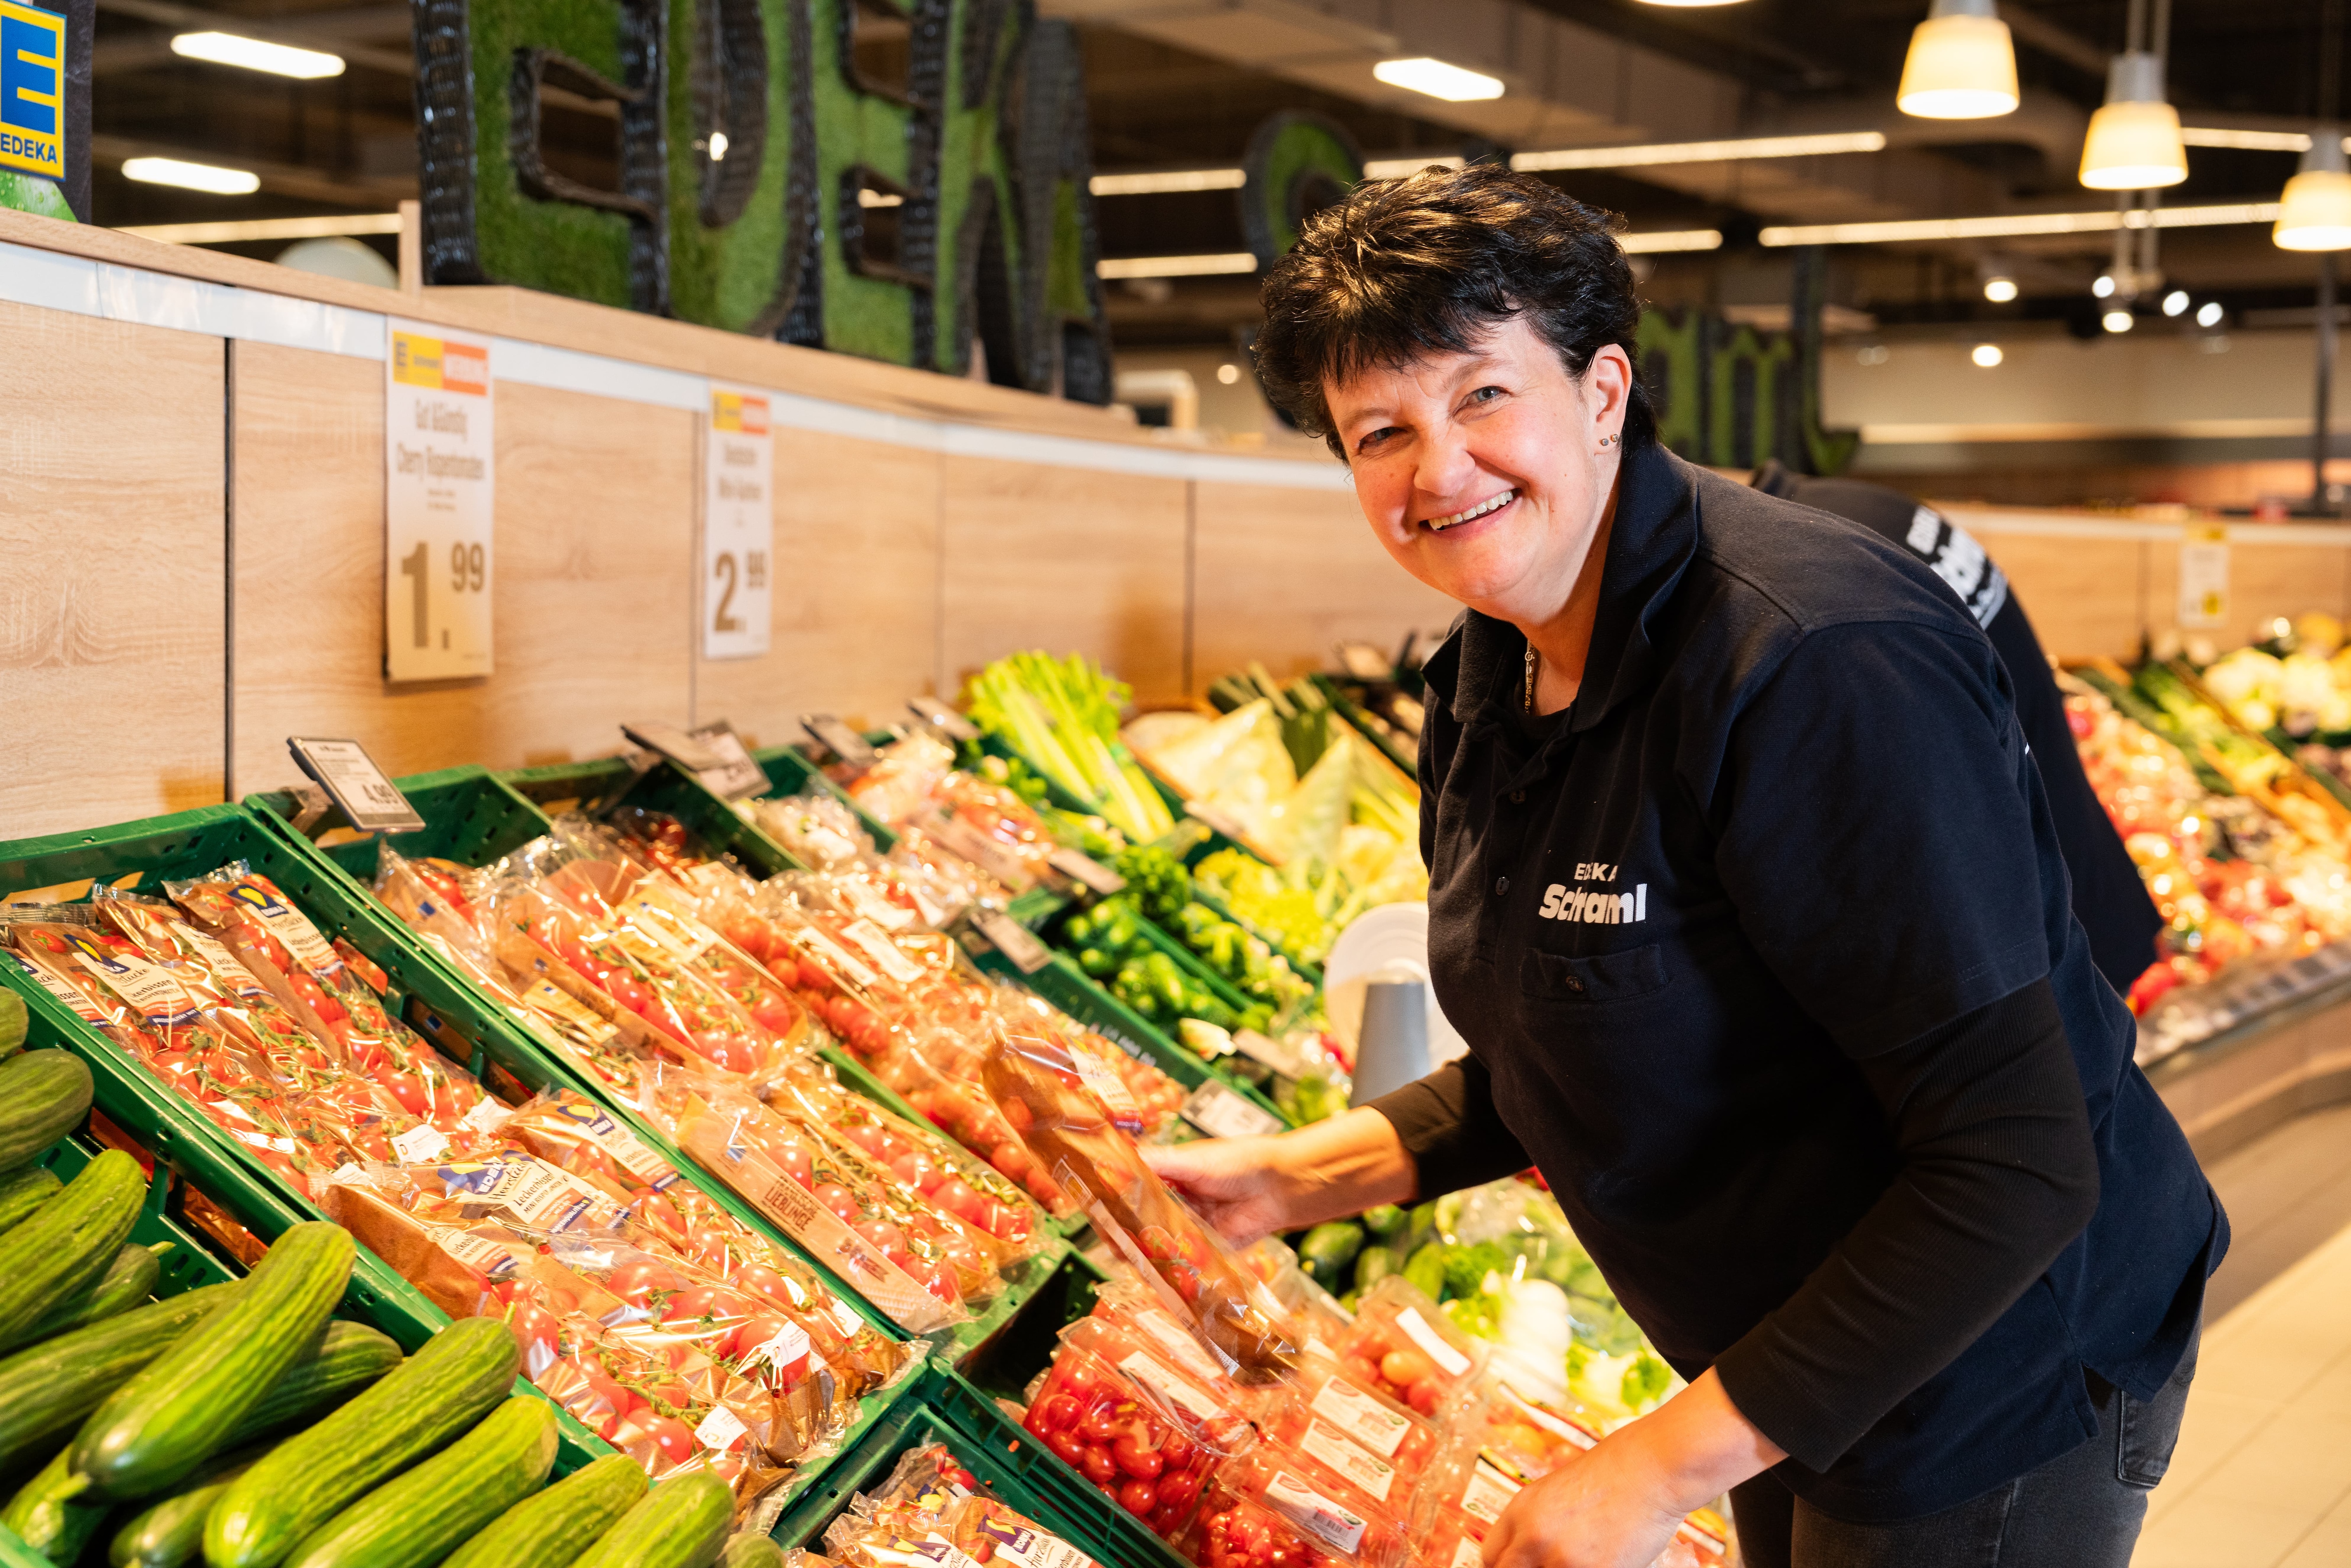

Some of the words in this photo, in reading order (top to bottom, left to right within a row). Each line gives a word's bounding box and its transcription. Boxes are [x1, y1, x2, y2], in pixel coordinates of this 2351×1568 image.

[1, 15, 56, 134] E
[0, 133, 57, 163] EDEKA
[764, 1186, 813, 1231] LIEBLINGE
